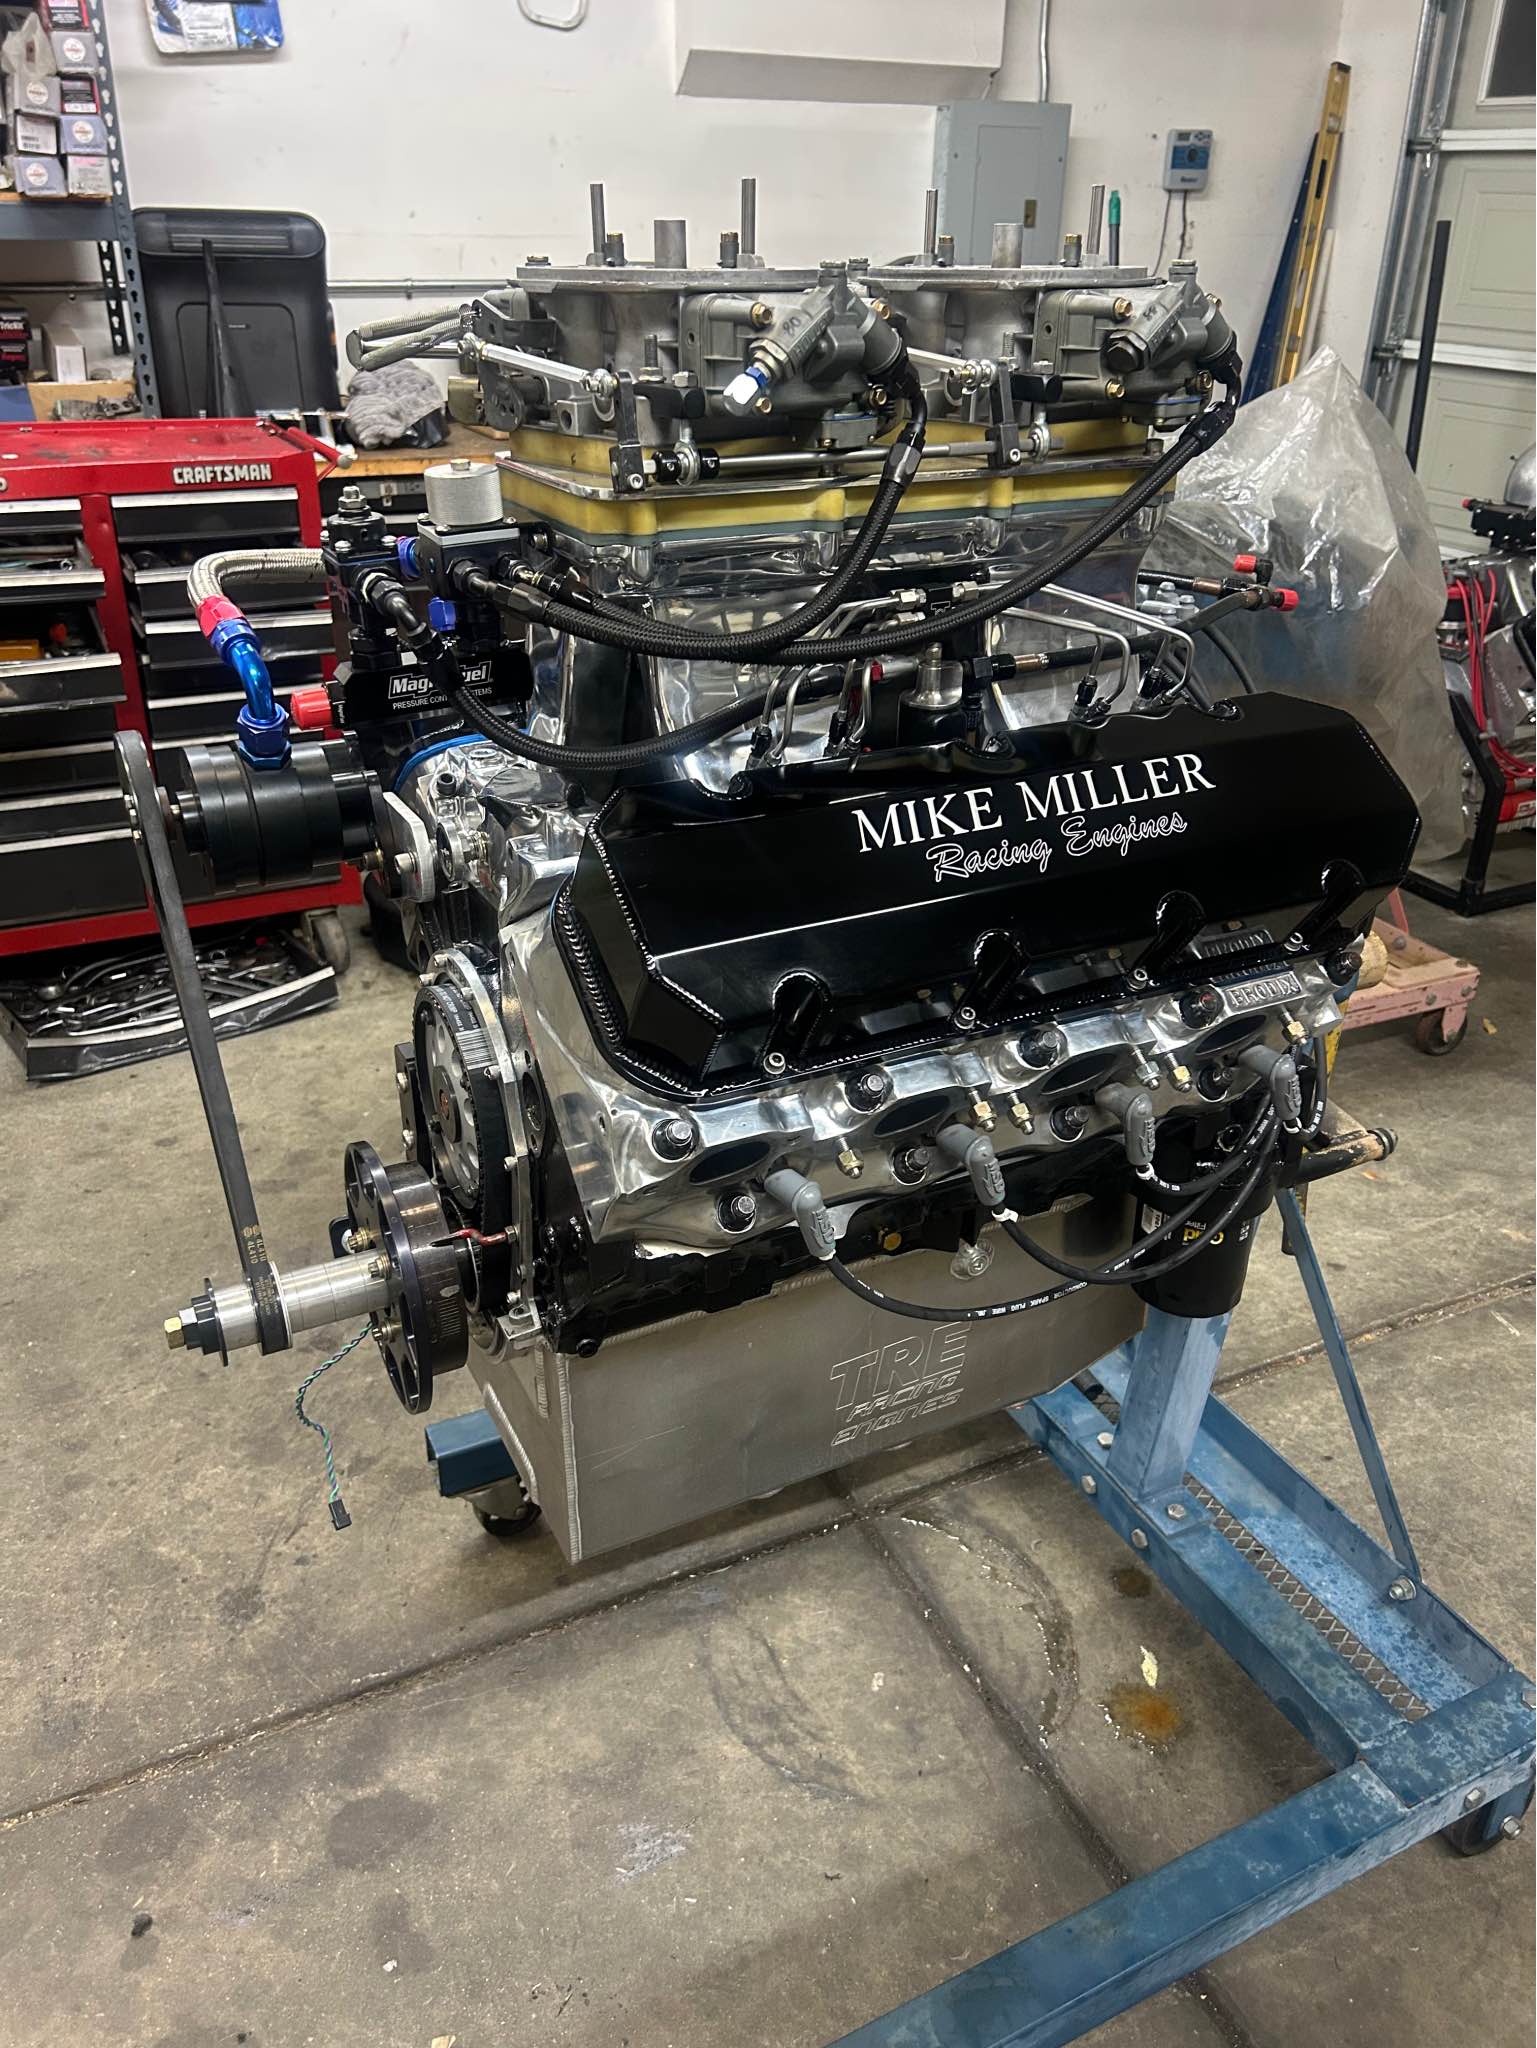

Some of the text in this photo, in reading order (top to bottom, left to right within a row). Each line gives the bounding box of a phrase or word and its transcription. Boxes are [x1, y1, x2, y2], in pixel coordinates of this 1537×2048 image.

[173, 463, 272, 484] CRAFTSMAN
[392, 665, 487, 694] Maguel
[393, 697, 429, 710] PRESSURE
[851, 753, 1217, 853] MIKE MILLER
[926, 811, 1187, 882] Racing Engines
[1228, 975, 1300, 1007] BRODIX
[830, 1321, 973, 1411] TRE
